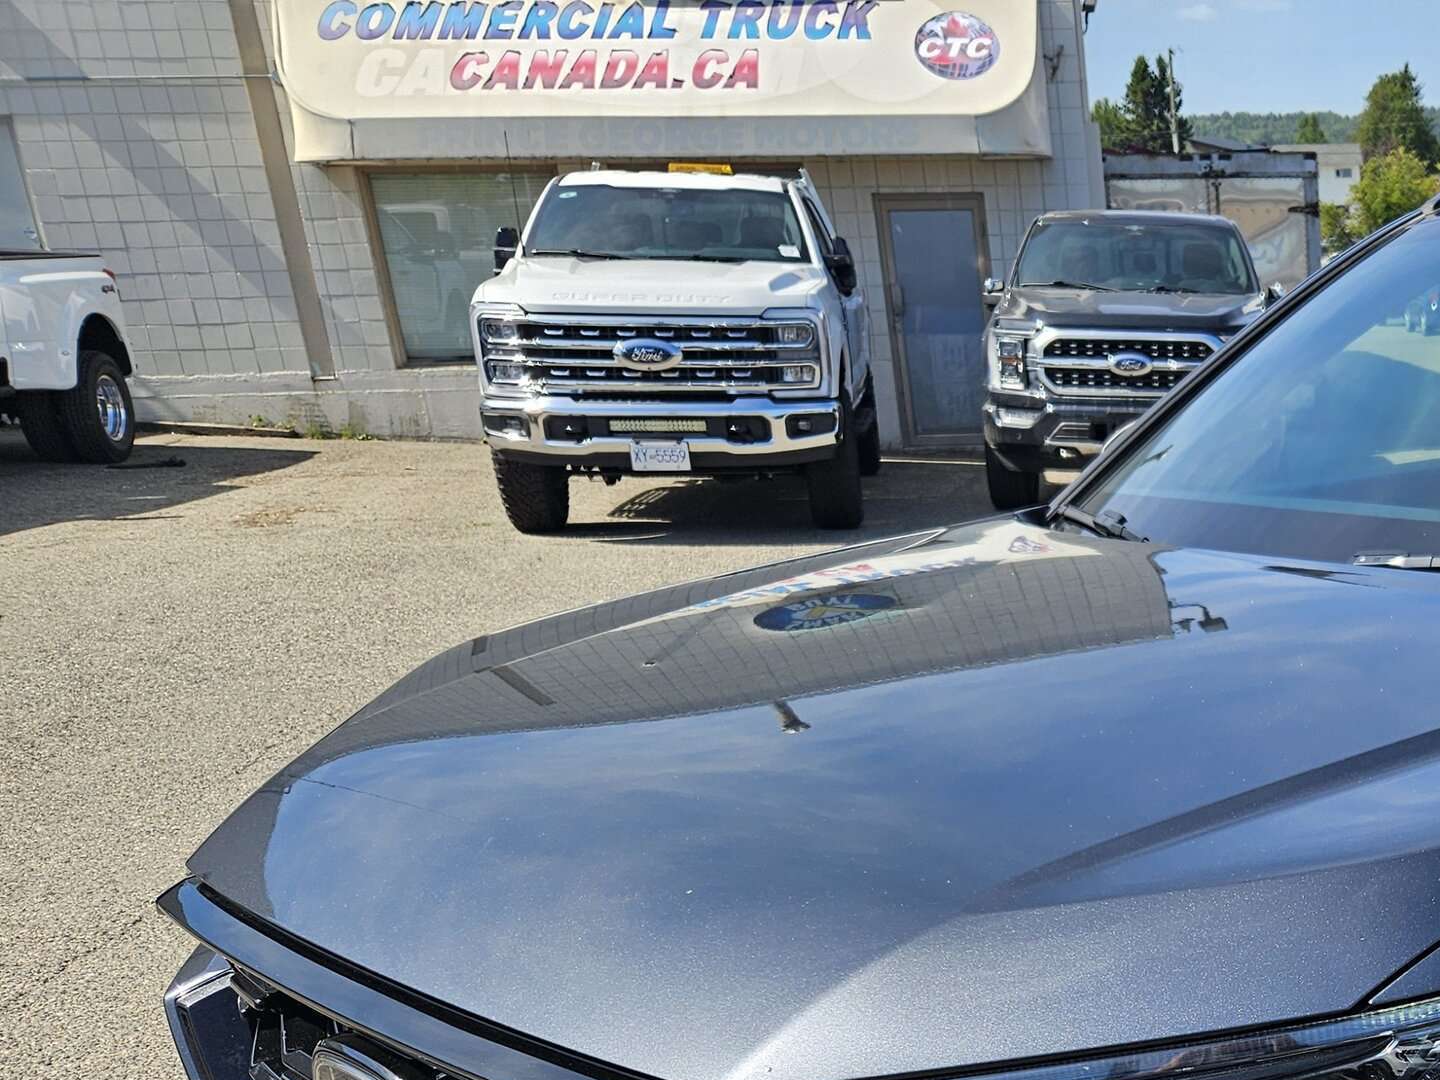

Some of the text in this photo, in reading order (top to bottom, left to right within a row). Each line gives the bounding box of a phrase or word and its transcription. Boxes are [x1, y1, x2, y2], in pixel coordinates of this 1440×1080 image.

[317, 0, 880, 41] COMMERCIAL TRUCK
[918, 37, 992, 58] CTC
[449, 48, 760, 91] CANADA.CA
[755, 120, 921, 148] MOTORS
[631, 347, 663, 362] Ford
[1120, 359, 1142, 370] Ford
